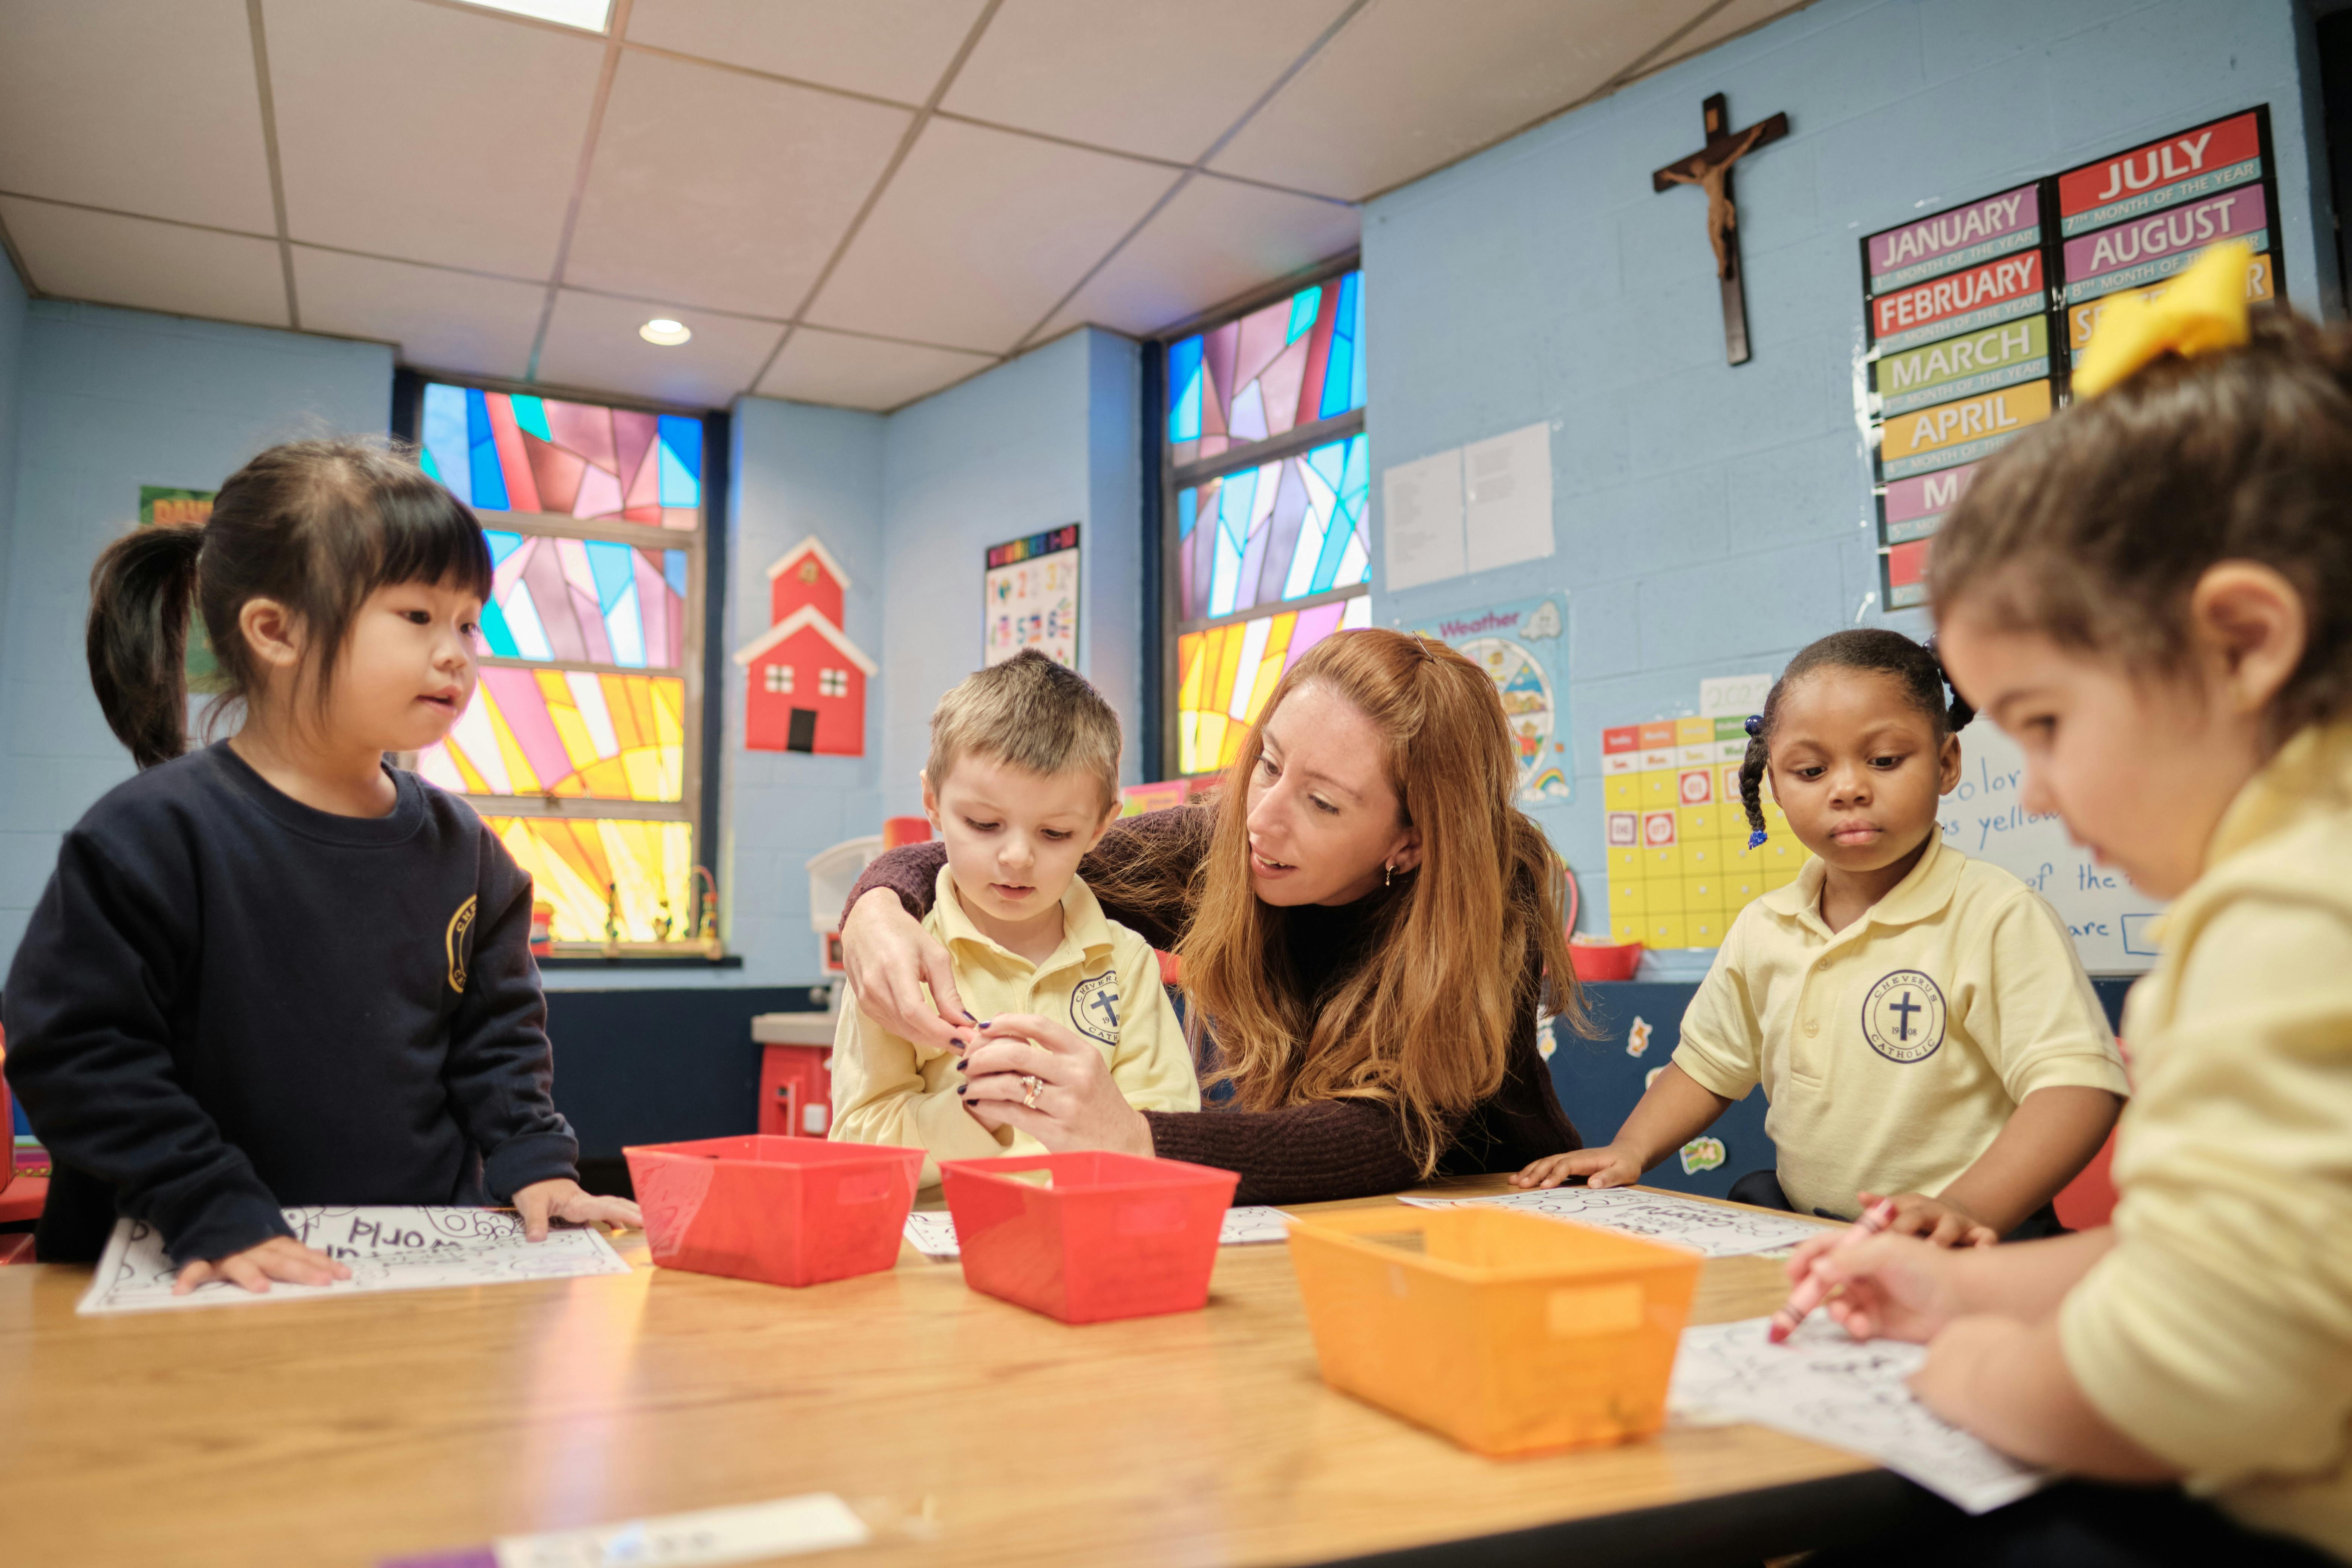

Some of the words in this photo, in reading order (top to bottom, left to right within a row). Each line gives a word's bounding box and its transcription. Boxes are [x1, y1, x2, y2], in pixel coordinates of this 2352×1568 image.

[2098, 131, 2212, 201] JULY
[2094, 195, 2148, 223] MONTH
[2154, 188, 2174, 204] OF
[2180, 177, 2208, 196] THE
[2214, 164, 2254, 184] YEAR
[1883, 194, 2021, 267] JANUARY
[2090, 197, 2236, 271] AUGUST
[1897, 259, 1943, 280] MONTH
[1948, 252, 1966, 265] OF
[1970, 243, 1994, 257] THE
[1999, 231, 2032, 249] YEAR
[2073, 280, 2095, 297] 8TH
[2101, 266, 2154, 289] MONTH
[2160, 257, 2179, 273] OF
[1880, 255, 2035, 331] FEBRUARY
[1905, 322, 1950, 342] MONTH
[1955, 316, 1972, 329] OF
[1977, 309, 2000, 323] THE
[2005, 297, 2037, 314] YEAR
[1893, 325, 2029, 389] MARCH
[1907, 385, 1953, 404] MONTH
[1957, 378, 1975, 392] OF
[1980, 372, 2003, 387] THE
[2008, 361, 2041, 378] YEAR
[1911, 396, 2017, 449] APRIL
[1911, 450, 1957, 469] MONTH
[1962, 444, 1978, 456] OF
[1983, 437, 2007, 451] THE
[1440, 610, 1522, 637] Weather
[1943, 817, 1959, 836] is
[1978, 804, 2060, 851] yellow
[2025, 862, 2053, 891] of
[2078, 864, 2116, 891] the
[2068, 922, 2109, 936] are
[1874, 976, 1937, 1002] CHEVERUS
[1871, 1034, 1935, 1058] CATHOLIC
